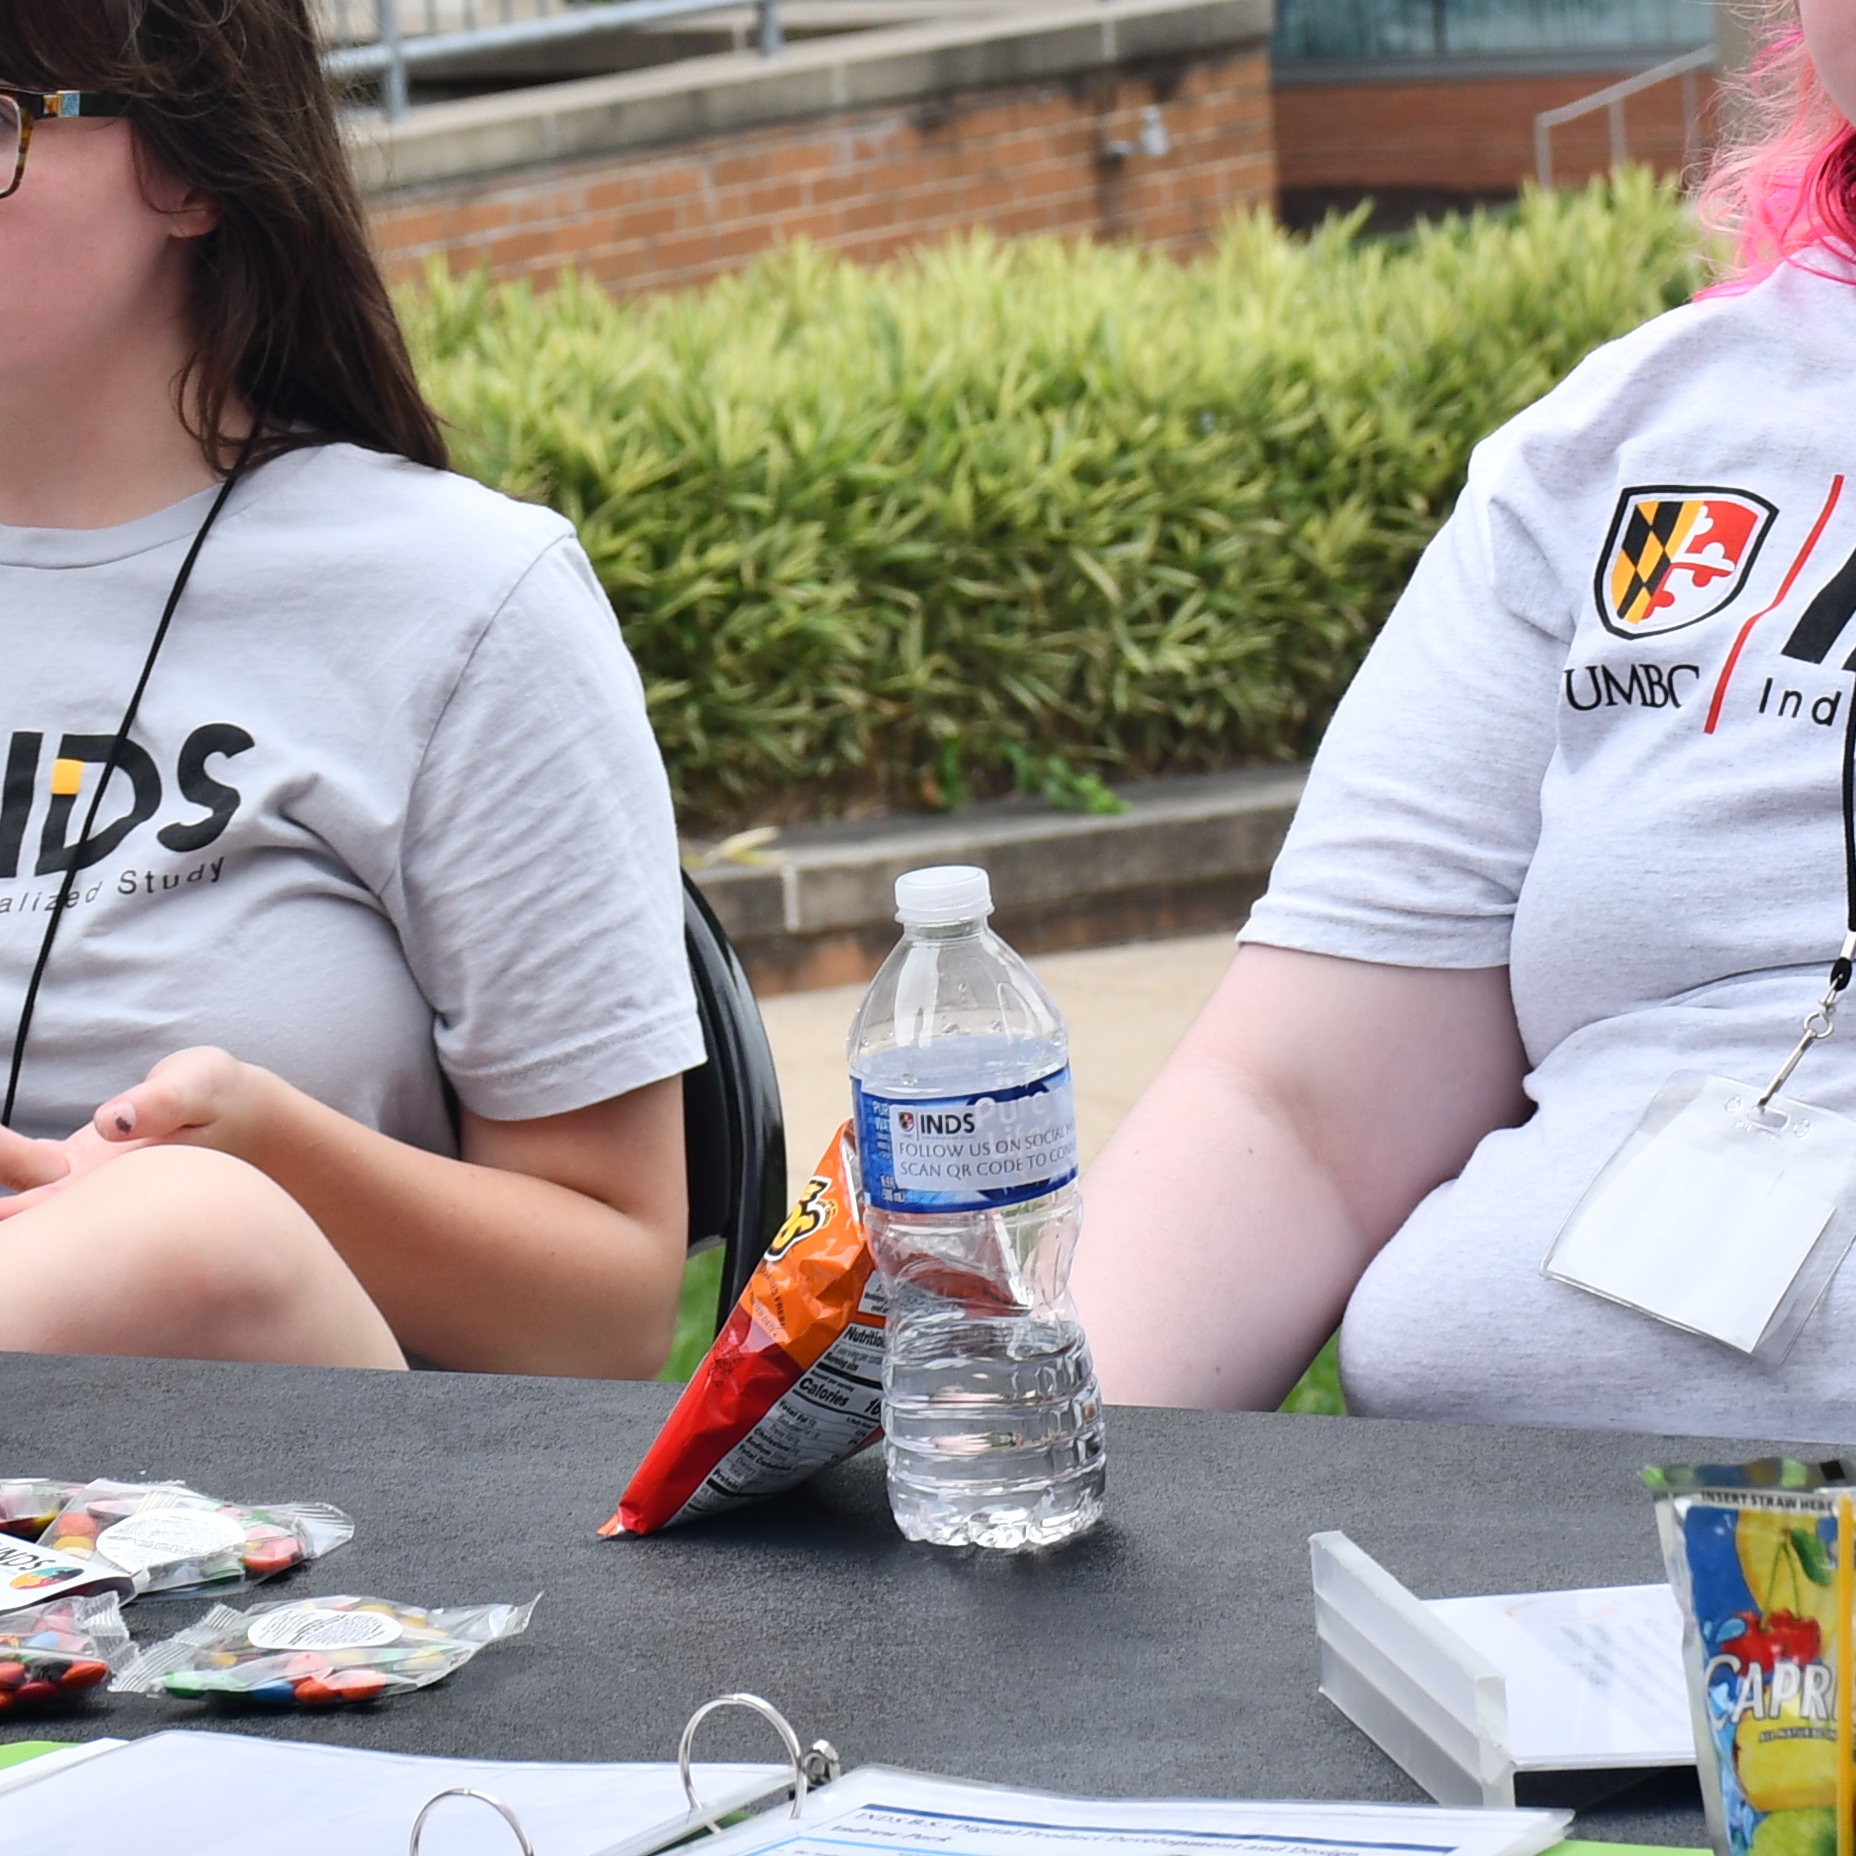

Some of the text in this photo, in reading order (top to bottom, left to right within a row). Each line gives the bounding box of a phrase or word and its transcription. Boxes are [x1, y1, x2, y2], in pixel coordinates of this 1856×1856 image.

[1564, 663, 1700, 712] UMBC
[117, 856, 225, 895] Study
[920, 1112, 976, 1135] INDS
[899, 1141, 964, 1158] FOLLOW
[969, 1142, 991, 1157] US
[995, 1137, 1021, 1154] ON
[1025, 1128, 1065, 1150] SOCIAL
[900, 1161, 941, 1178] SCAN
[946, 1161, 972, 1180] QR
[976, 1156, 1023, 1176] CODE
[1027, 1153, 1047, 1170] TO
[798, 1376, 883, 1417] Calories 16
[1700, 1492, 1834, 1513] INSERT STRAW HERE
[1706, 1653, 1839, 1731] CAPR
